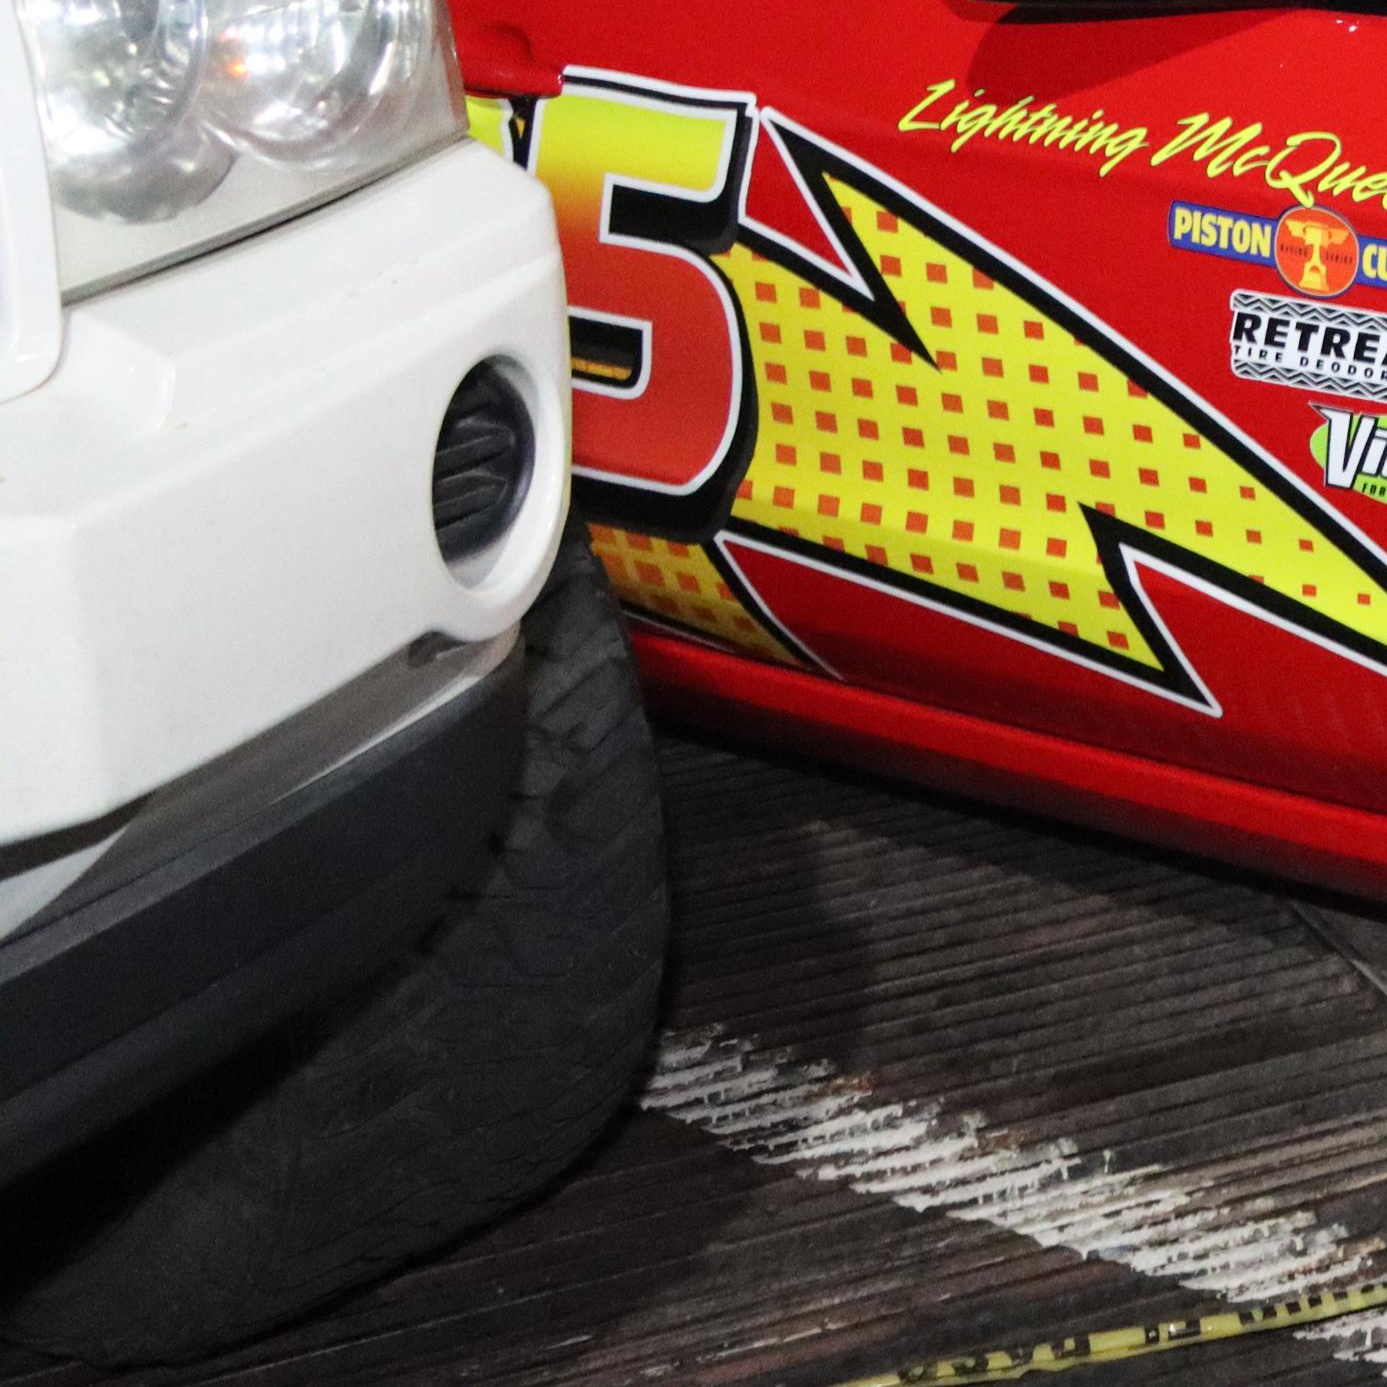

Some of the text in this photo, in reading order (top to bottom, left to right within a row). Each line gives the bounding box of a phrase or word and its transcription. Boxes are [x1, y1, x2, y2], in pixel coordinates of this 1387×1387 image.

[898, 79, 1149, 176] Lightning
[1174, 209, 1271, 257] PISTON
[1234, 345, 1284, 363] TIRE
[1361, 482, 1387, 496] FOR
